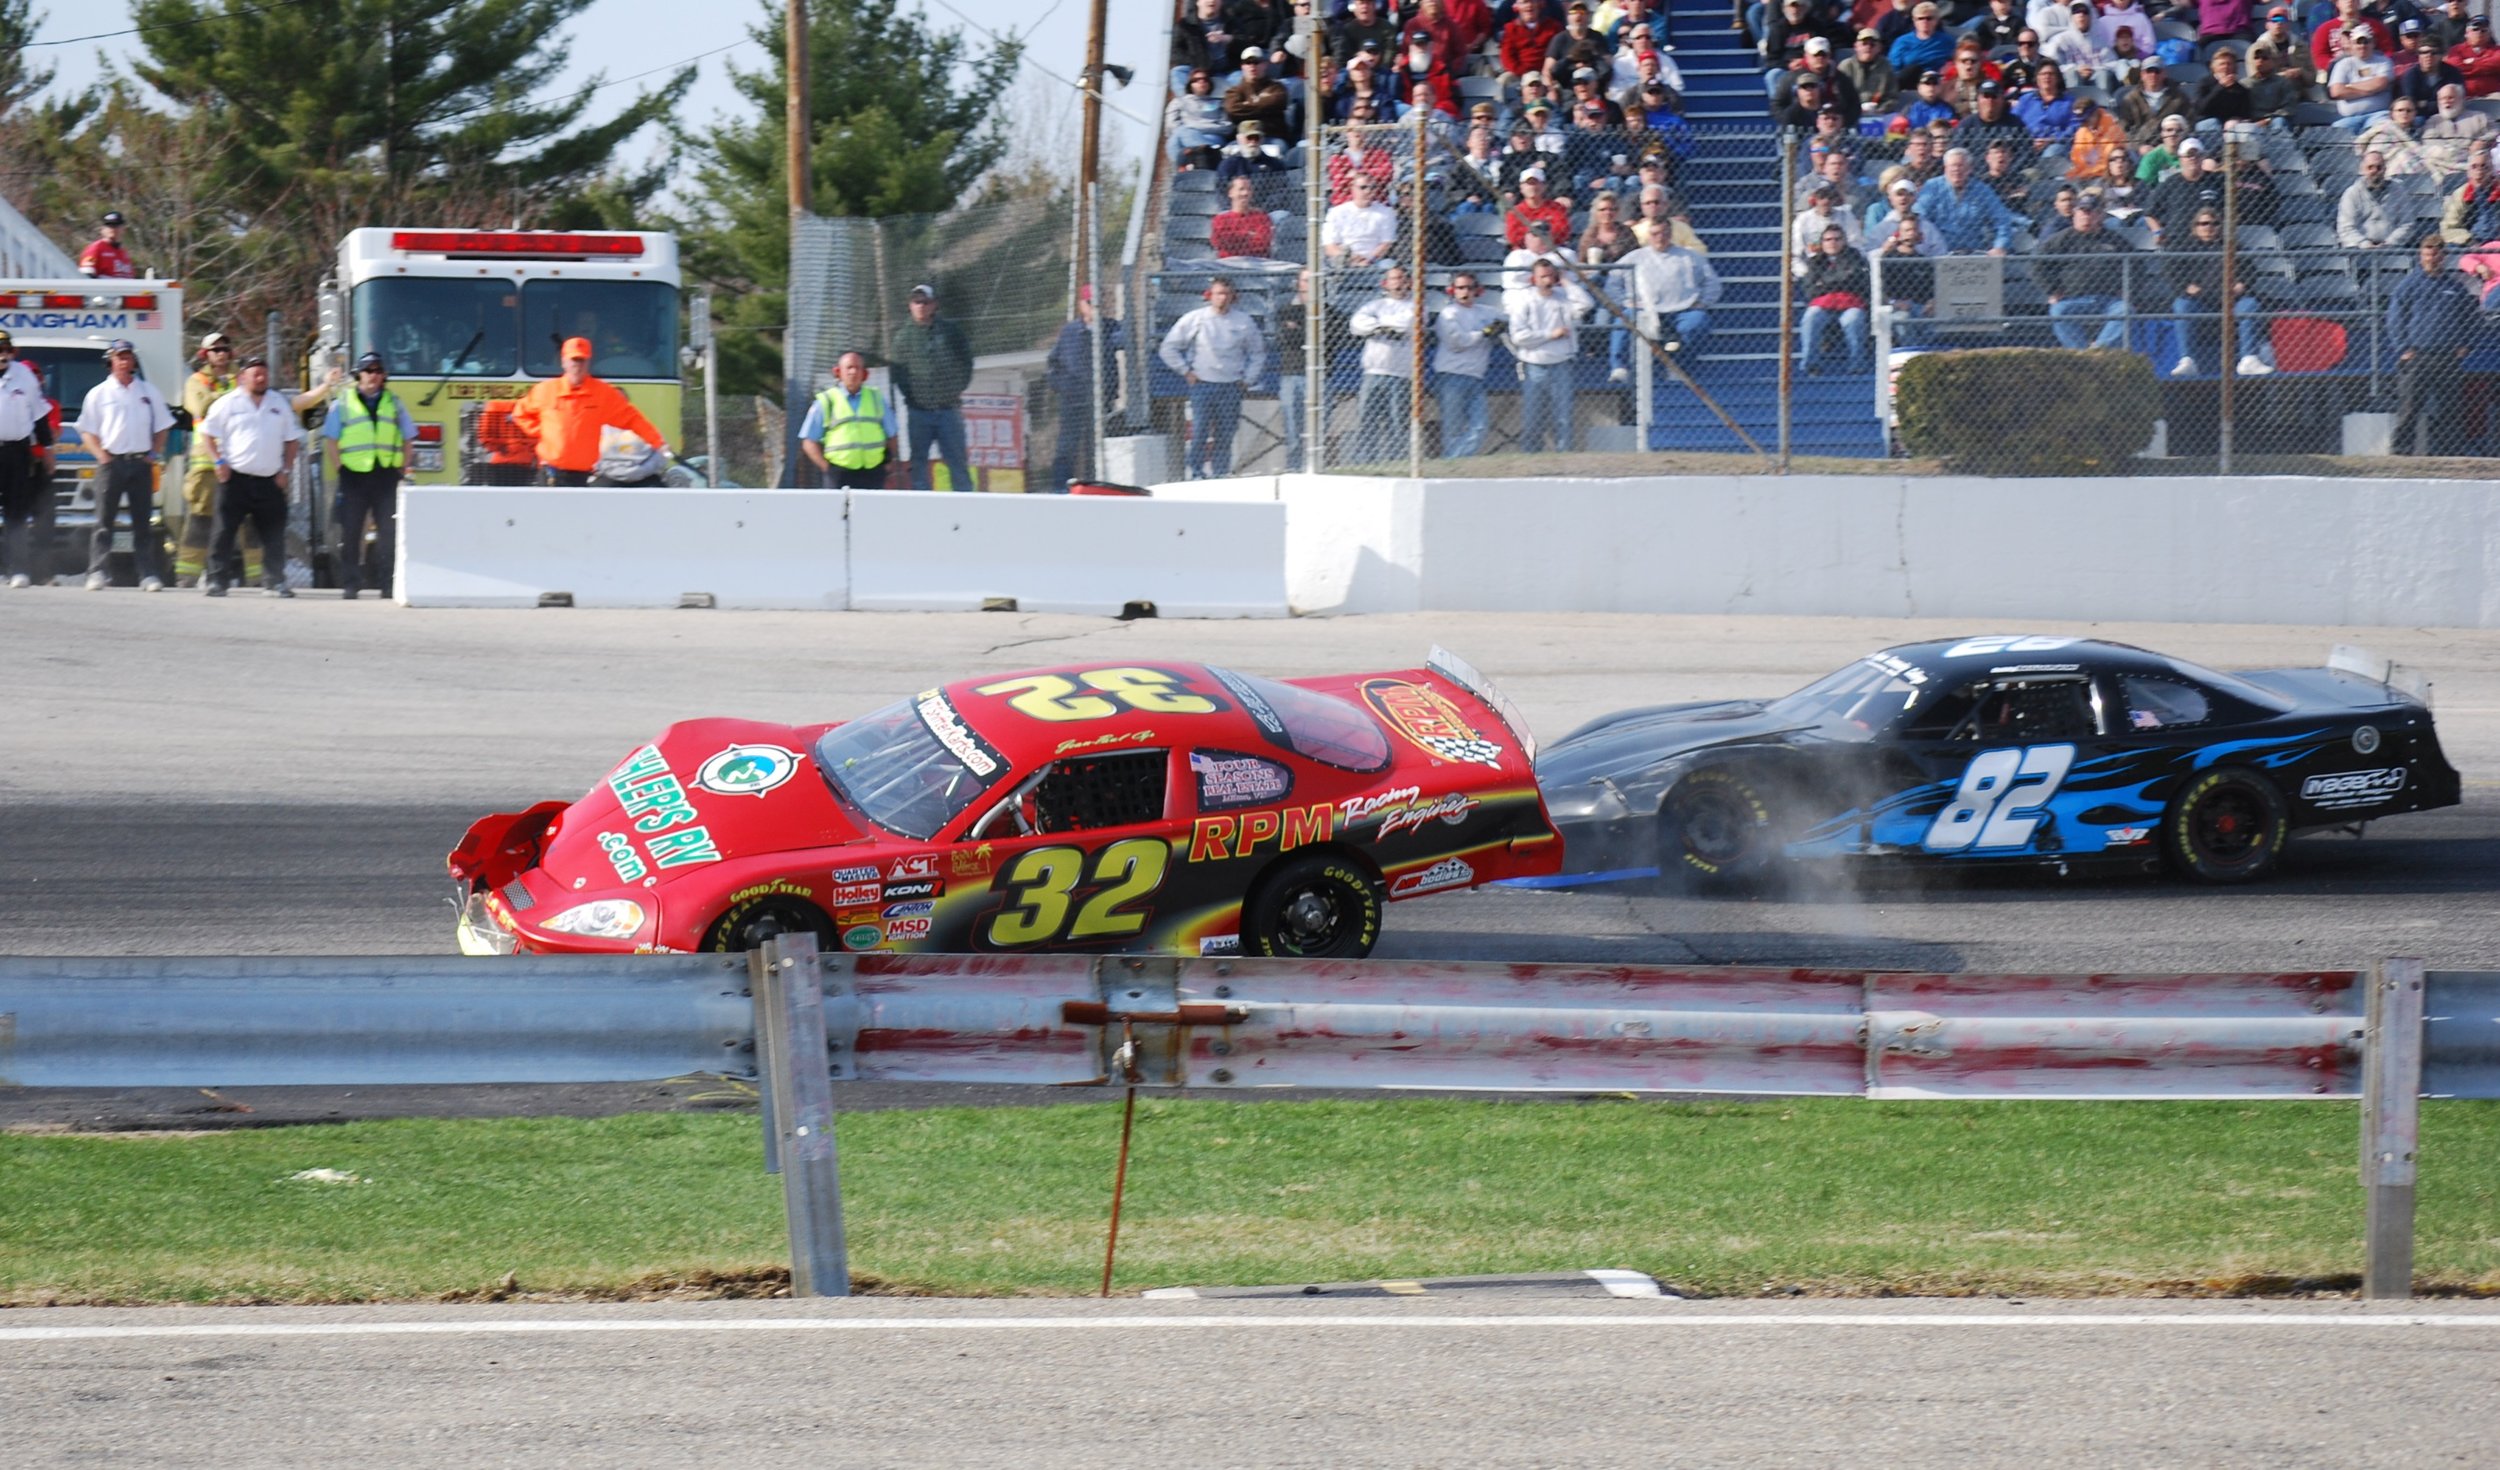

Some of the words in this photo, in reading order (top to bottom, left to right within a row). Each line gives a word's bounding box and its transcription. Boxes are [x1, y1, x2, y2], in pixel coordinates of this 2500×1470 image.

[1214, 759, 1260, 771] FOUR
[1204, 768, 1275, 785] SEASONS
[1203, 783, 1235, 797] REAL
[1236, 779, 1282, 793] ESTATE
[1923, 745, 2076, 852] 82
[1340, 786, 1420, 829] Racing
[1376, 796, 1479, 841] Engines
[1189, 803, 1333, 862] RPM
[597, 831, 647, 883] .com
[888, 854, 938, 877] ACT
[834, 867, 876, 879] QUARTER
[841, 873, 879, 882] MASTER
[836, 885, 879, 899] Holley
[884, 884, 933, 896] KONI
[988, 837, 1169, 945] 32
[890, 918, 929, 933] MSD
[888, 931, 926, 940] IGNITION
